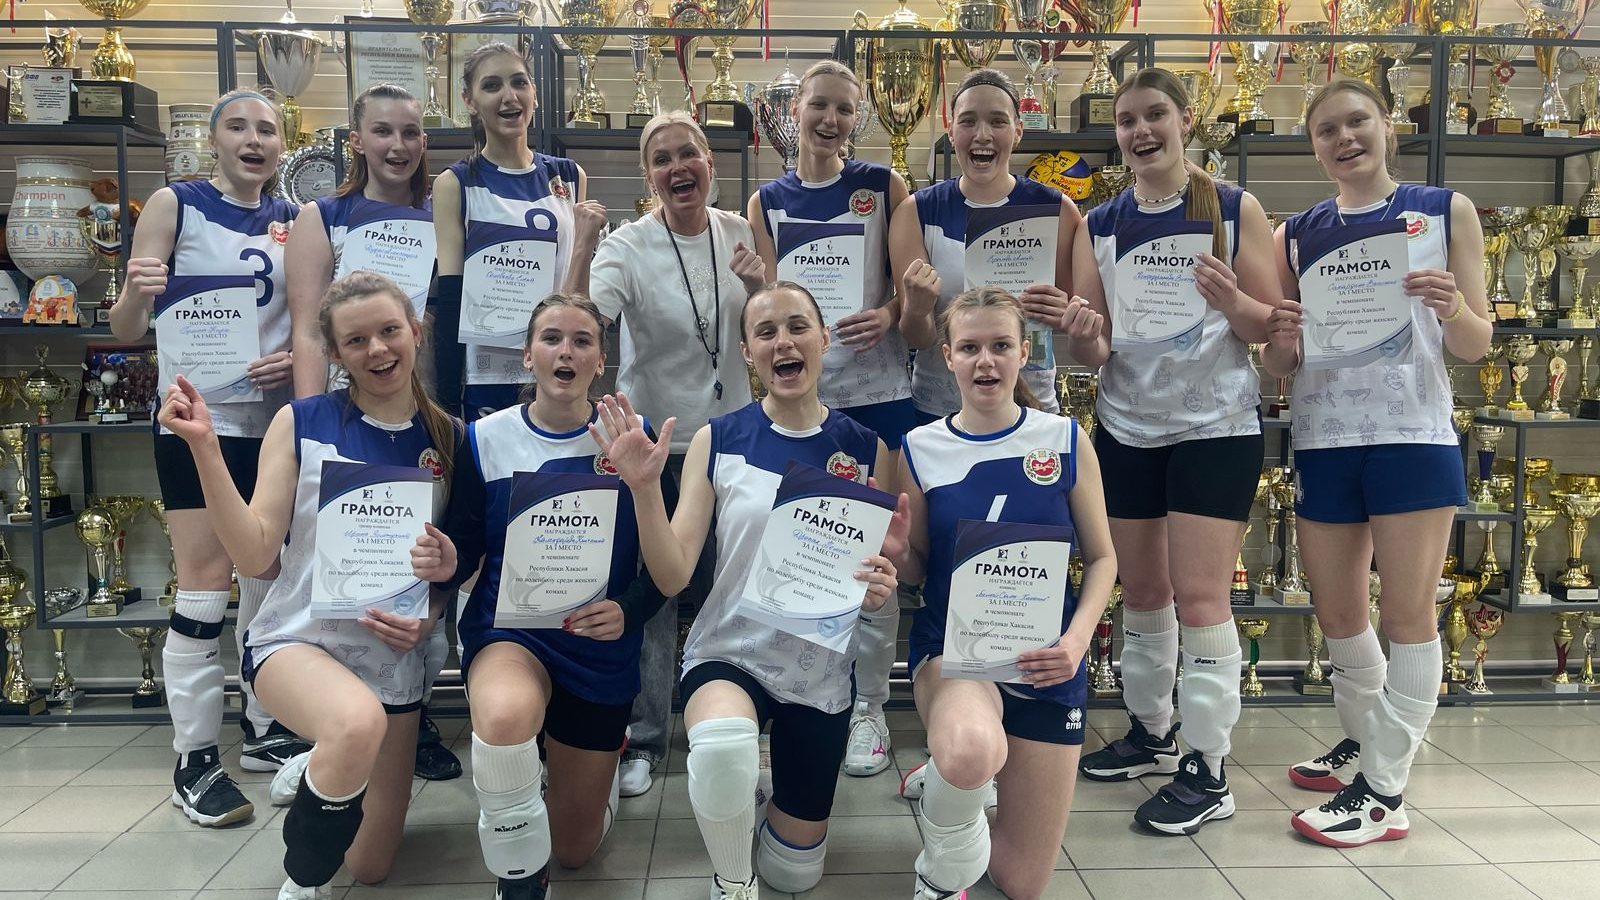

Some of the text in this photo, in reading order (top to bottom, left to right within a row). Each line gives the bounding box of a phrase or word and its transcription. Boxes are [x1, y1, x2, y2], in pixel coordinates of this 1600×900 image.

[365, 230, 423, 248] ГРАМОТА
[983, 238, 1042, 249] ГРАМОТА
[483, 255, 541, 270] ГРАМОТА
[794, 256, 850, 265] ГРАМОТА
[1134, 256, 1194, 267] ГРАМОТА
[1320, 260, 1391, 276] ГРАМОТА
[240, 248, 274, 307] 3
[1335, 274, 1378, 282] НАГРАЖДАЕТСЯ
[175, 310, 241, 319] ГРАМОТА
[341, 503, 414, 518] ГРАМОТА
[531, 515, 599, 527] ГРАМОТА
[793, 508, 865, 543] ГРАМОТА
[805, 526, 848, 545] НАГРАЖДАЕТСЯ
[815, 546, 840, 560] МЕСТО
[782, 558, 842, 584] Республики Хакасия
[975, 563, 1048, 579] ГРАМОТА
[775, 568, 804, 585] волейболу
[806, 581, 823, 592] среди
[824, 587, 848, 600] женских
[793, 589, 815, 601] команд
[973, 619, 1008, 627] Республики
[969, 631, 999, 639] волейболу
